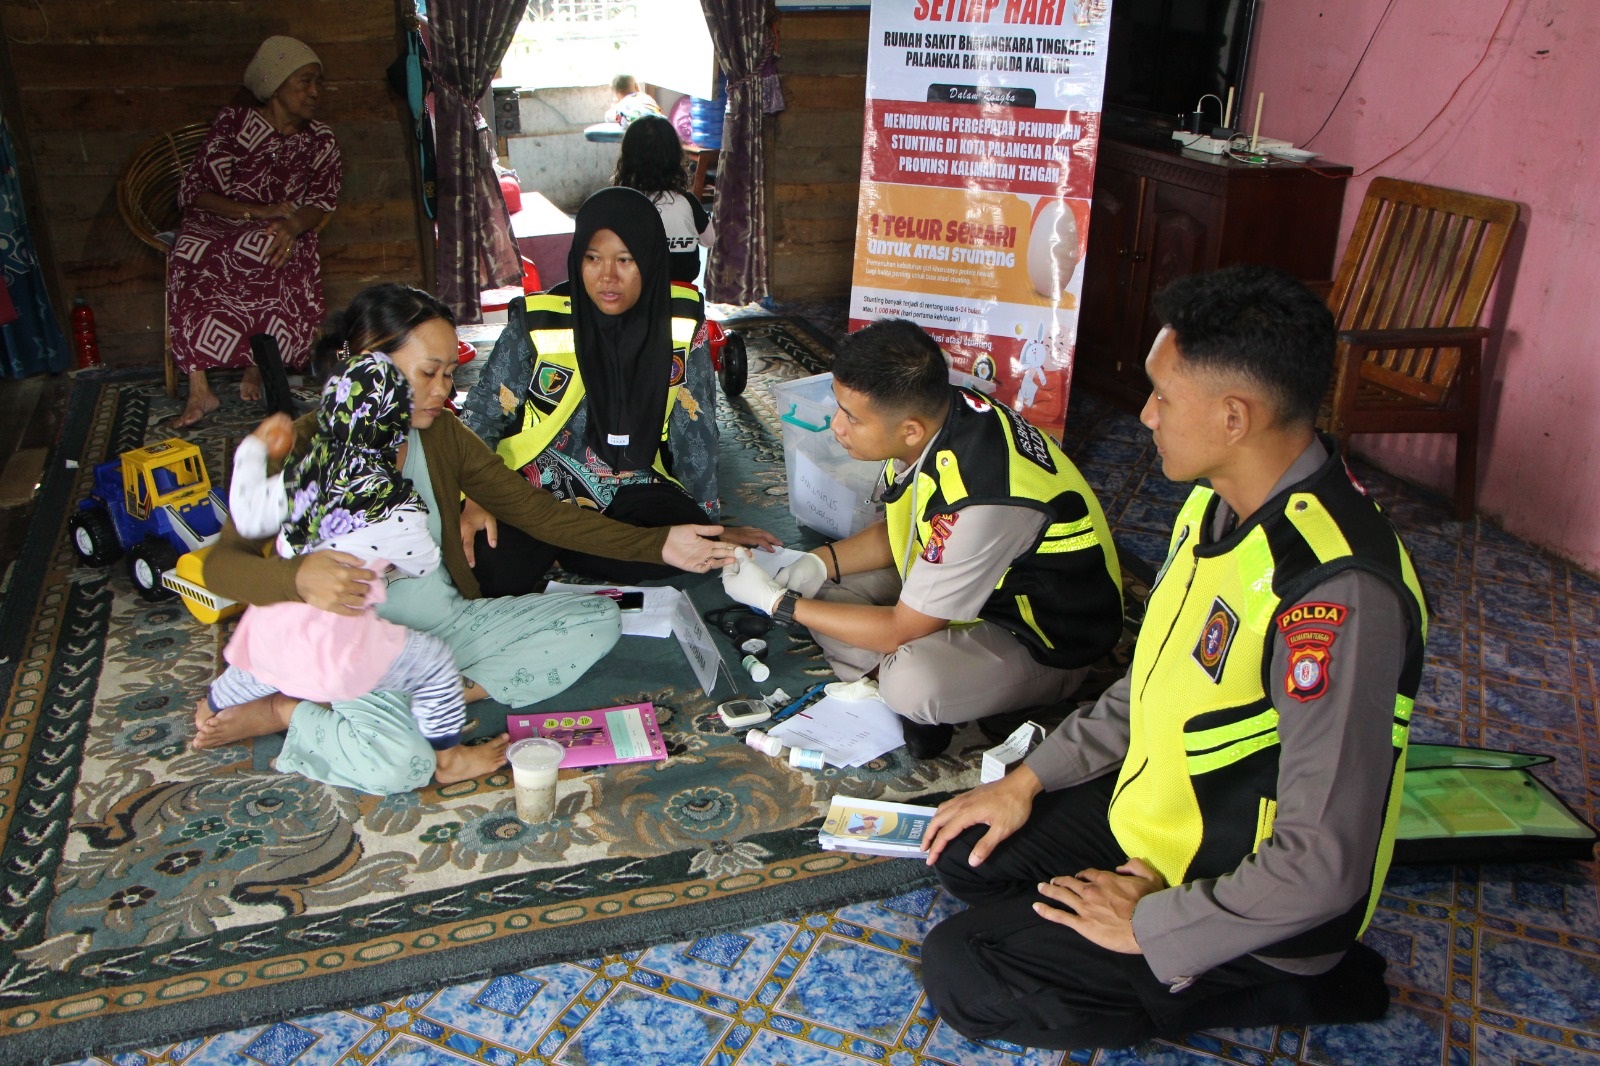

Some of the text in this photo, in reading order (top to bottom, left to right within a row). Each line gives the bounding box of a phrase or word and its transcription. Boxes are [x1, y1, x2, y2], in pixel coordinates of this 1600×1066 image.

[913, 0, 1066, 26] SETIAP HARI
[884, 31, 923, 48] RUMAH
[924, 33, 956, 50] SAKIT
[958, 34, 1033, 53] BHAYANGKARA
[1035, 37, 1082, 55] TINGKAT
[905, 51, 1070, 74] PALANGKA RAYA POLDA KALTENG
[950, 87, 1015, 106] Dalam Rangka
[883, 112, 1081, 140] MENDUKUNG PERCEPATAN PENURUNAN
[891, 135, 1070, 161] STUNTING DI KOTA PALANGKA RAYA
[899, 157, 1060, 183] PROVINSI KALIMANTAN TENGAH
[870, 213, 879, 236] 1
[913, 243, 950, 261] ATASI
[863, 295, 884, 305] Stunting
[885, 297, 902, 306] banyak
[903, 299, 919, 309] terjadi
[1282, 606, 1338, 627] POLDA
